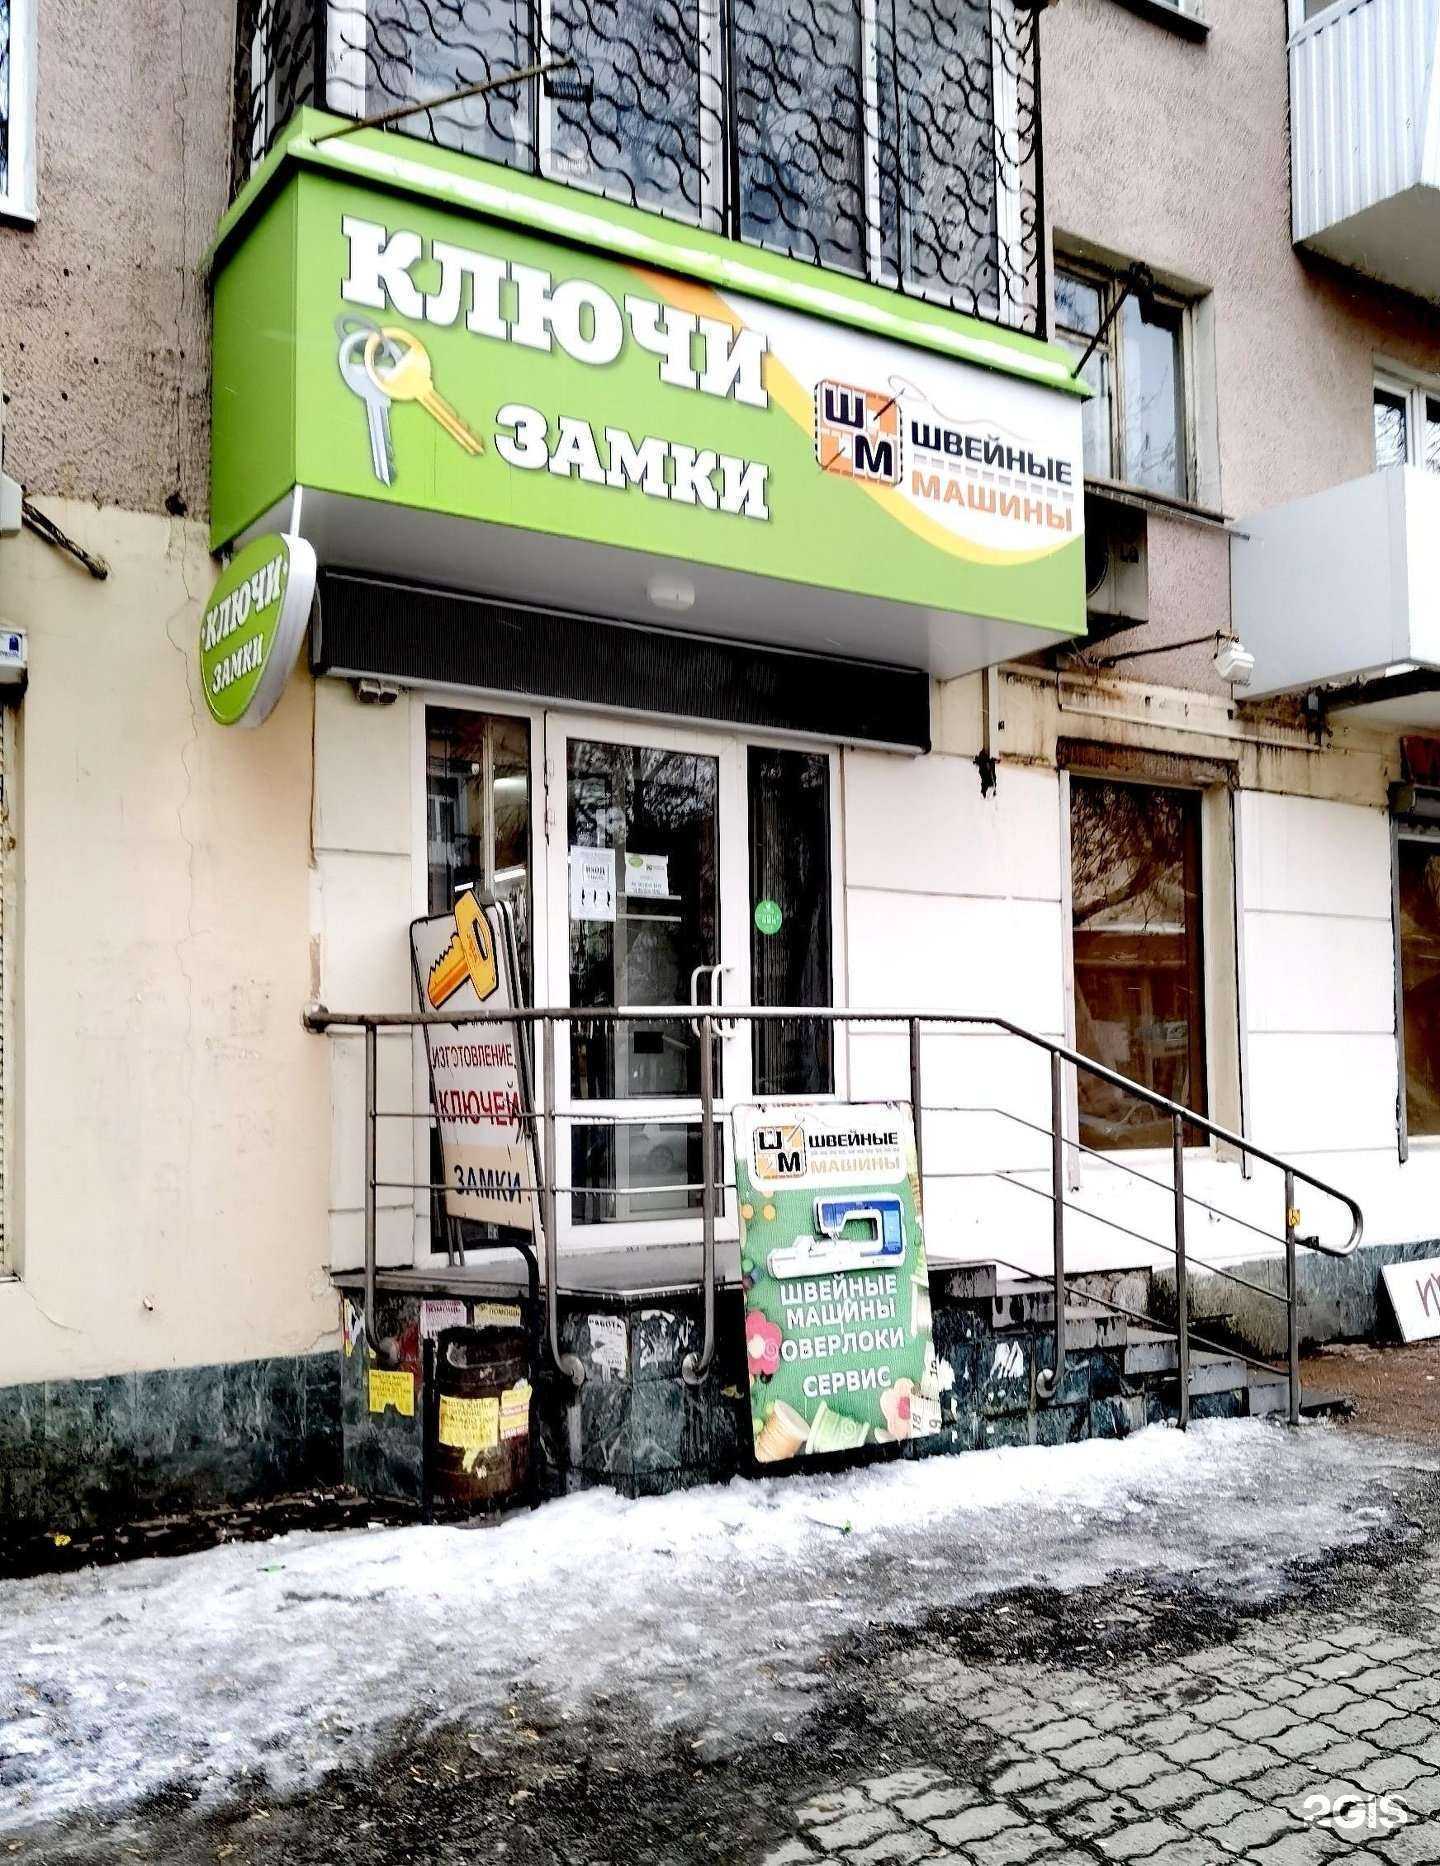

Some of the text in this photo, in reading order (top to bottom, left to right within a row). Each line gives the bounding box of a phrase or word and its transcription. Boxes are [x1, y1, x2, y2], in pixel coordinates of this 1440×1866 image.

[341, 215, 769, 408] КЛЮЧИ
[494, 403, 769, 520] ЗАМКИ
[911, 421, 1072, 486] ШВЕЙНЫЕ
[911, 469, 1072, 532] МАШИНЫ
[204, 554, 284, 652] КЛЮЧИ
[212, 632, 264, 695] ЗАМКИ
[431, 1044, 512, 1069] ИЗГОТОВЛЕНИЕ
[438, 1080, 522, 1127] КЛЮЧЕЙ
[808, 1130, 898, 1148] ШВЕЙНЫЕ
[454, 1164, 522, 1204] ЗАМКИ
[811, 1157, 900, 1174] МАШИНЫ
[780, 1273, 898, 1306] ШВЕЙНЫЕ
[781, 1326, 905, 1362] ОВЕРЛОКИ
[802, 1365, 892, 1397] СЕРВИС
